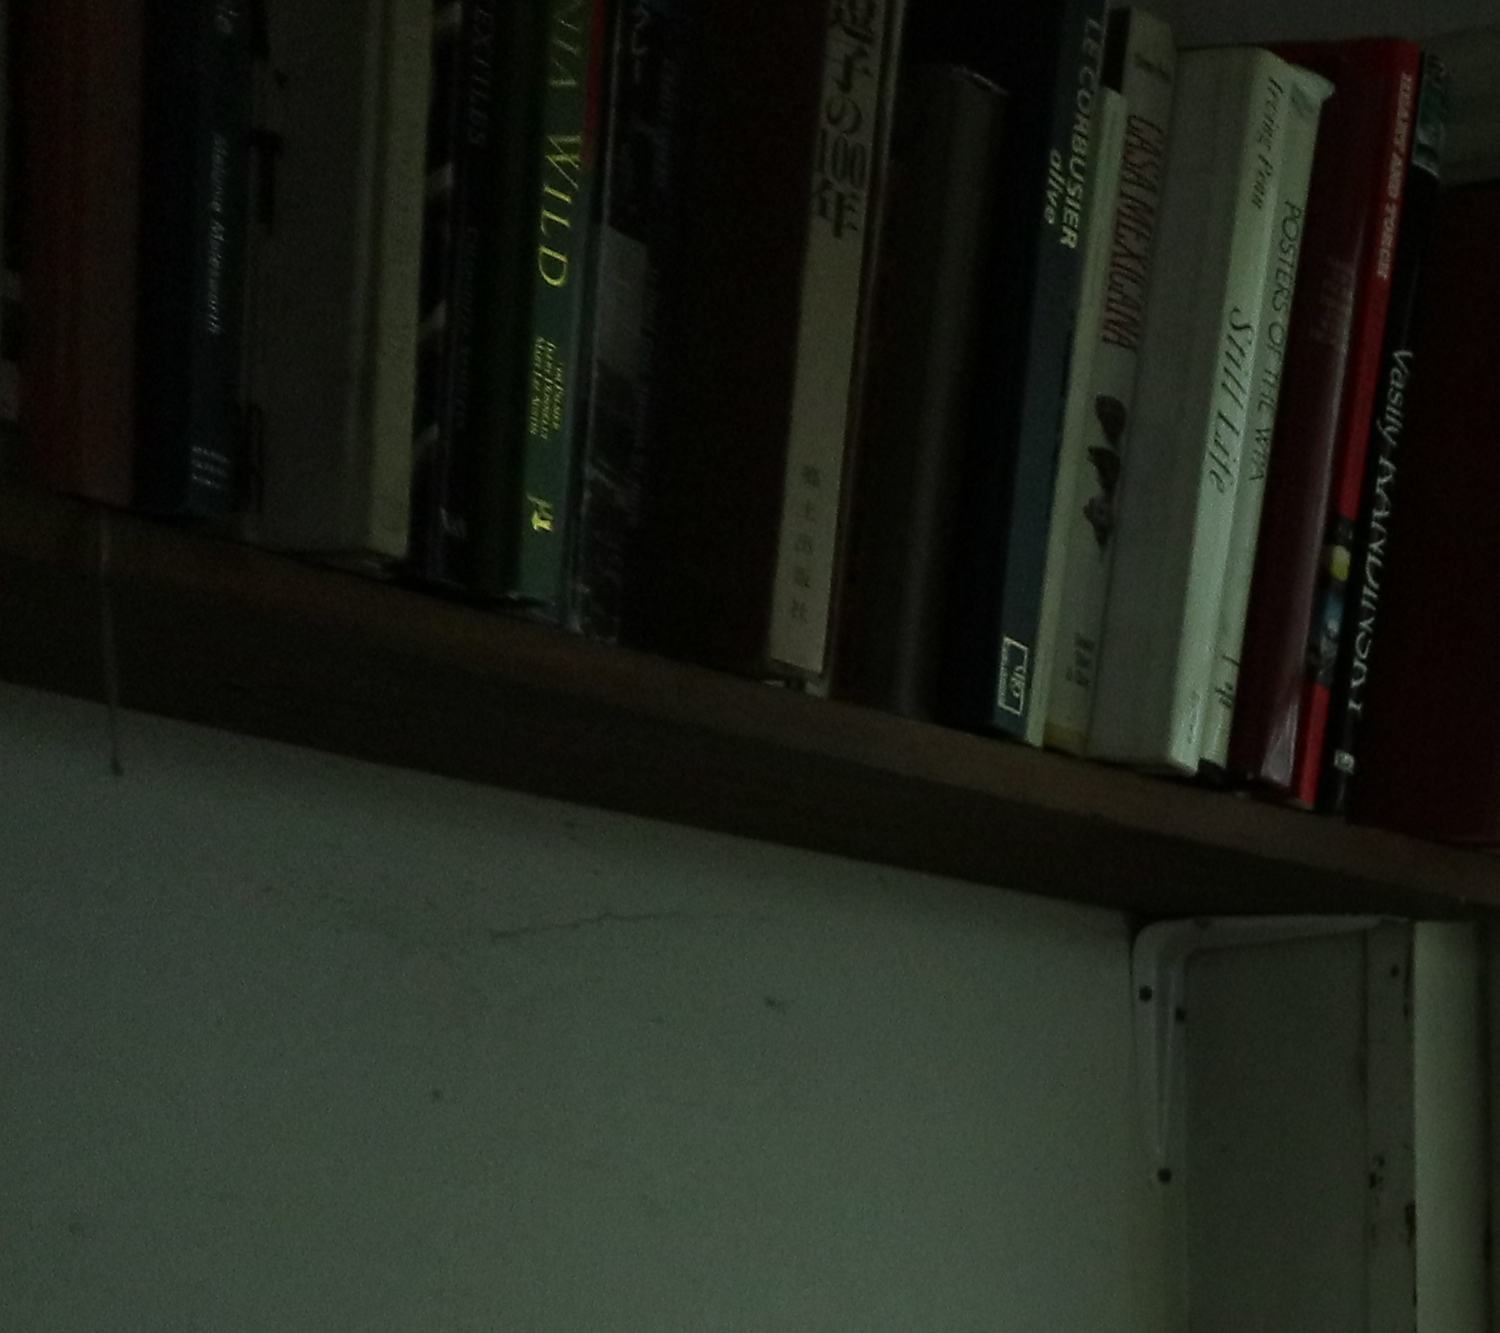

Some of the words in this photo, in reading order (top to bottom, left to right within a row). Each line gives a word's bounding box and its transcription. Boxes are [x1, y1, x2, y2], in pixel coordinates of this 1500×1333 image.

[466, 0, 498, 147] EXTILES
[1083, 17, 1104, 55] LE
[1043, 149, 1069, 225] alive
[1058, 65, 1102, 249] CORBUSIER
[1121, 114, 1164, 191] CASA
[1250, 153, 1274, 211] Penn
[1386, 152, 1403, 198] AND
[537, 132, 582, 288] WILD
[1101, 194, 1154, 351] MEXICANA
[1271, 200, 1302, 313] POSTERS
[1219, 305, 1254, 413] Still
[1264, 321, 1286, 357] OF
[1378, 348, 1414, 448] Vasily
[1207, 411, 1240, 494] Life
[1247, 425, 1272, 482] WPA
